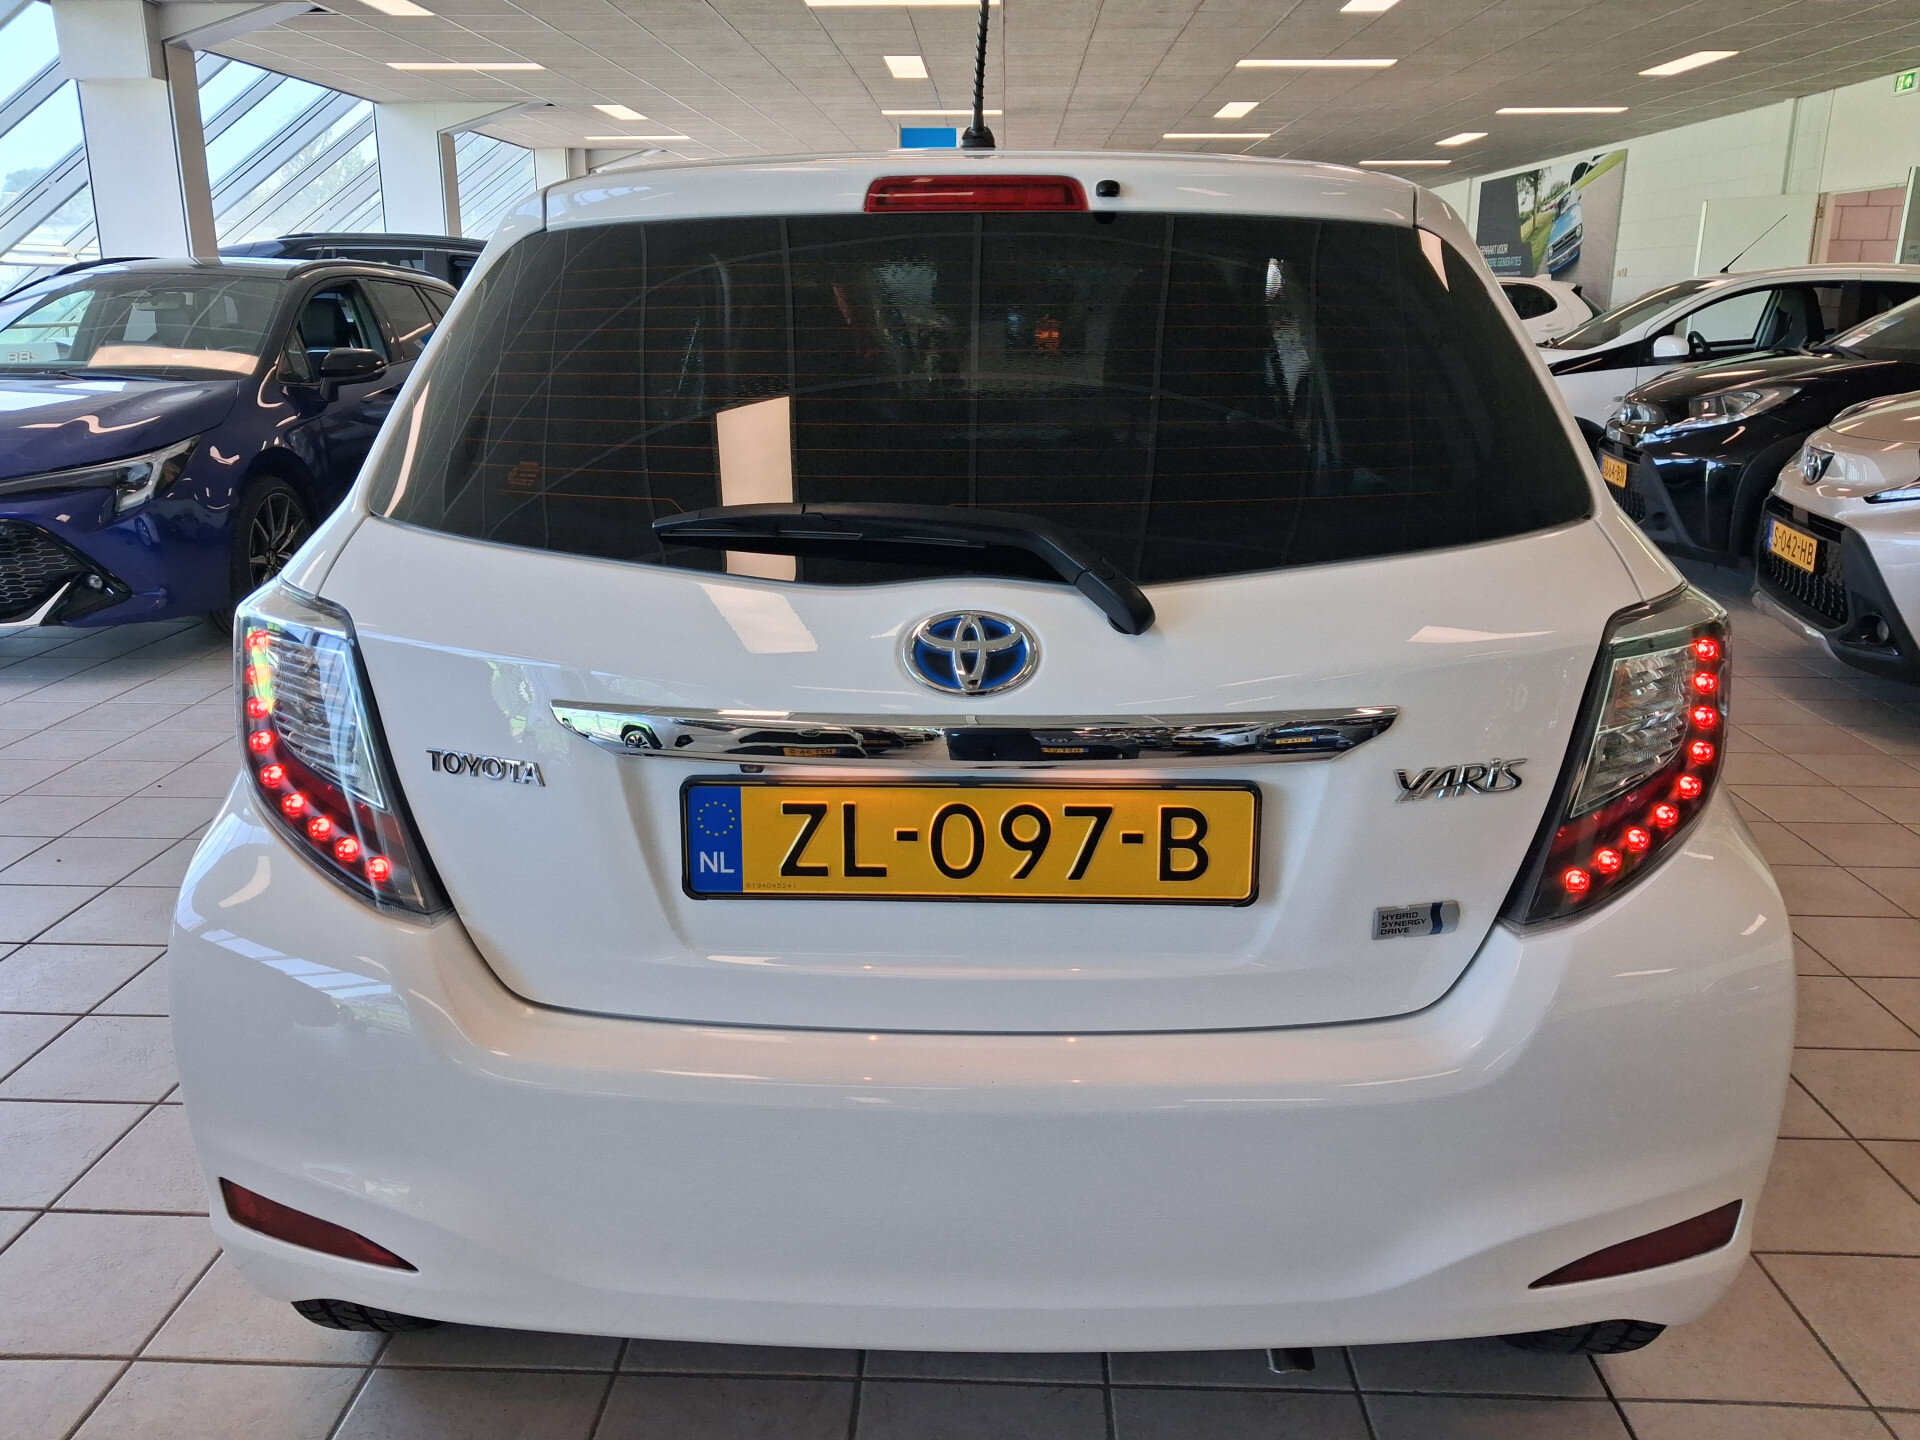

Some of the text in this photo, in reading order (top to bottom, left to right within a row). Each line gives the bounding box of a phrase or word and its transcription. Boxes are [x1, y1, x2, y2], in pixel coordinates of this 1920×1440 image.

[1773, 526, 1814, 566] S-042-HB
[426, 748, 546, 787] TOYOTA
[779, 801, 1210, 882] ZL-097-B
[699, 850, 736, 874] NL
[1381, 911, 1419, 921] HYBRID
[1381, 919, 1427, 929] SYNERGY
[1380, 926, 1410, 936] DRIVE
